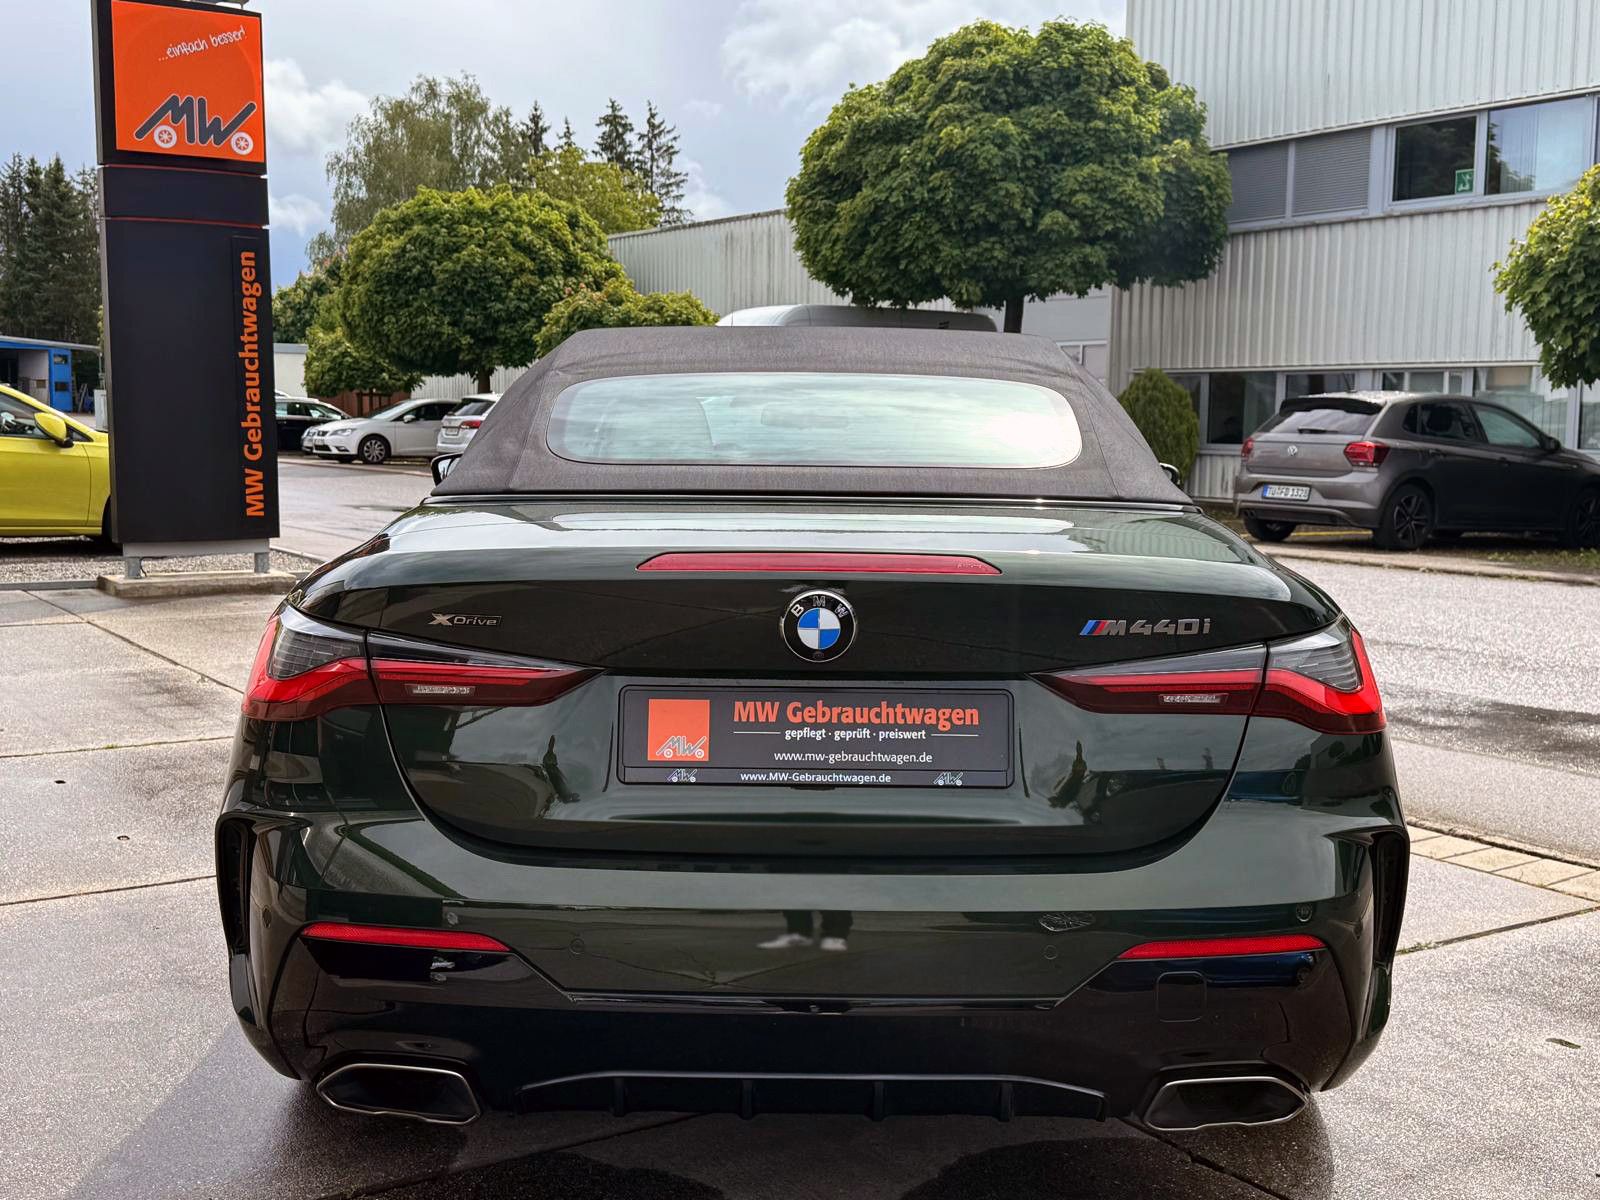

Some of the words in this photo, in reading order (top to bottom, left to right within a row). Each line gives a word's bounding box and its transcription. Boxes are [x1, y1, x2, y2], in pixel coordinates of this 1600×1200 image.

[134, 93, 257, 147] MW
[238, 250, 263, 462] Gebrauchtwagen
[245, 468, 265, 517] MW
[790, 595, 849, 619] BMW
[1099, 618, 1211, 636] M440i
[733, 700, 780, 723] MW
[786, 700, 980, 732] Gebrauchtwagen
[784, 727, 827, 741] gepflegt
[834, 728, 871, 742] geprüft
[878, 730, 926, 742] preiswert
[774, 750, 933, 765] www.mw-gebrauchtwagen.de
[740, 770, 892, 785] www.MW-Gebrauchtwagen.de
